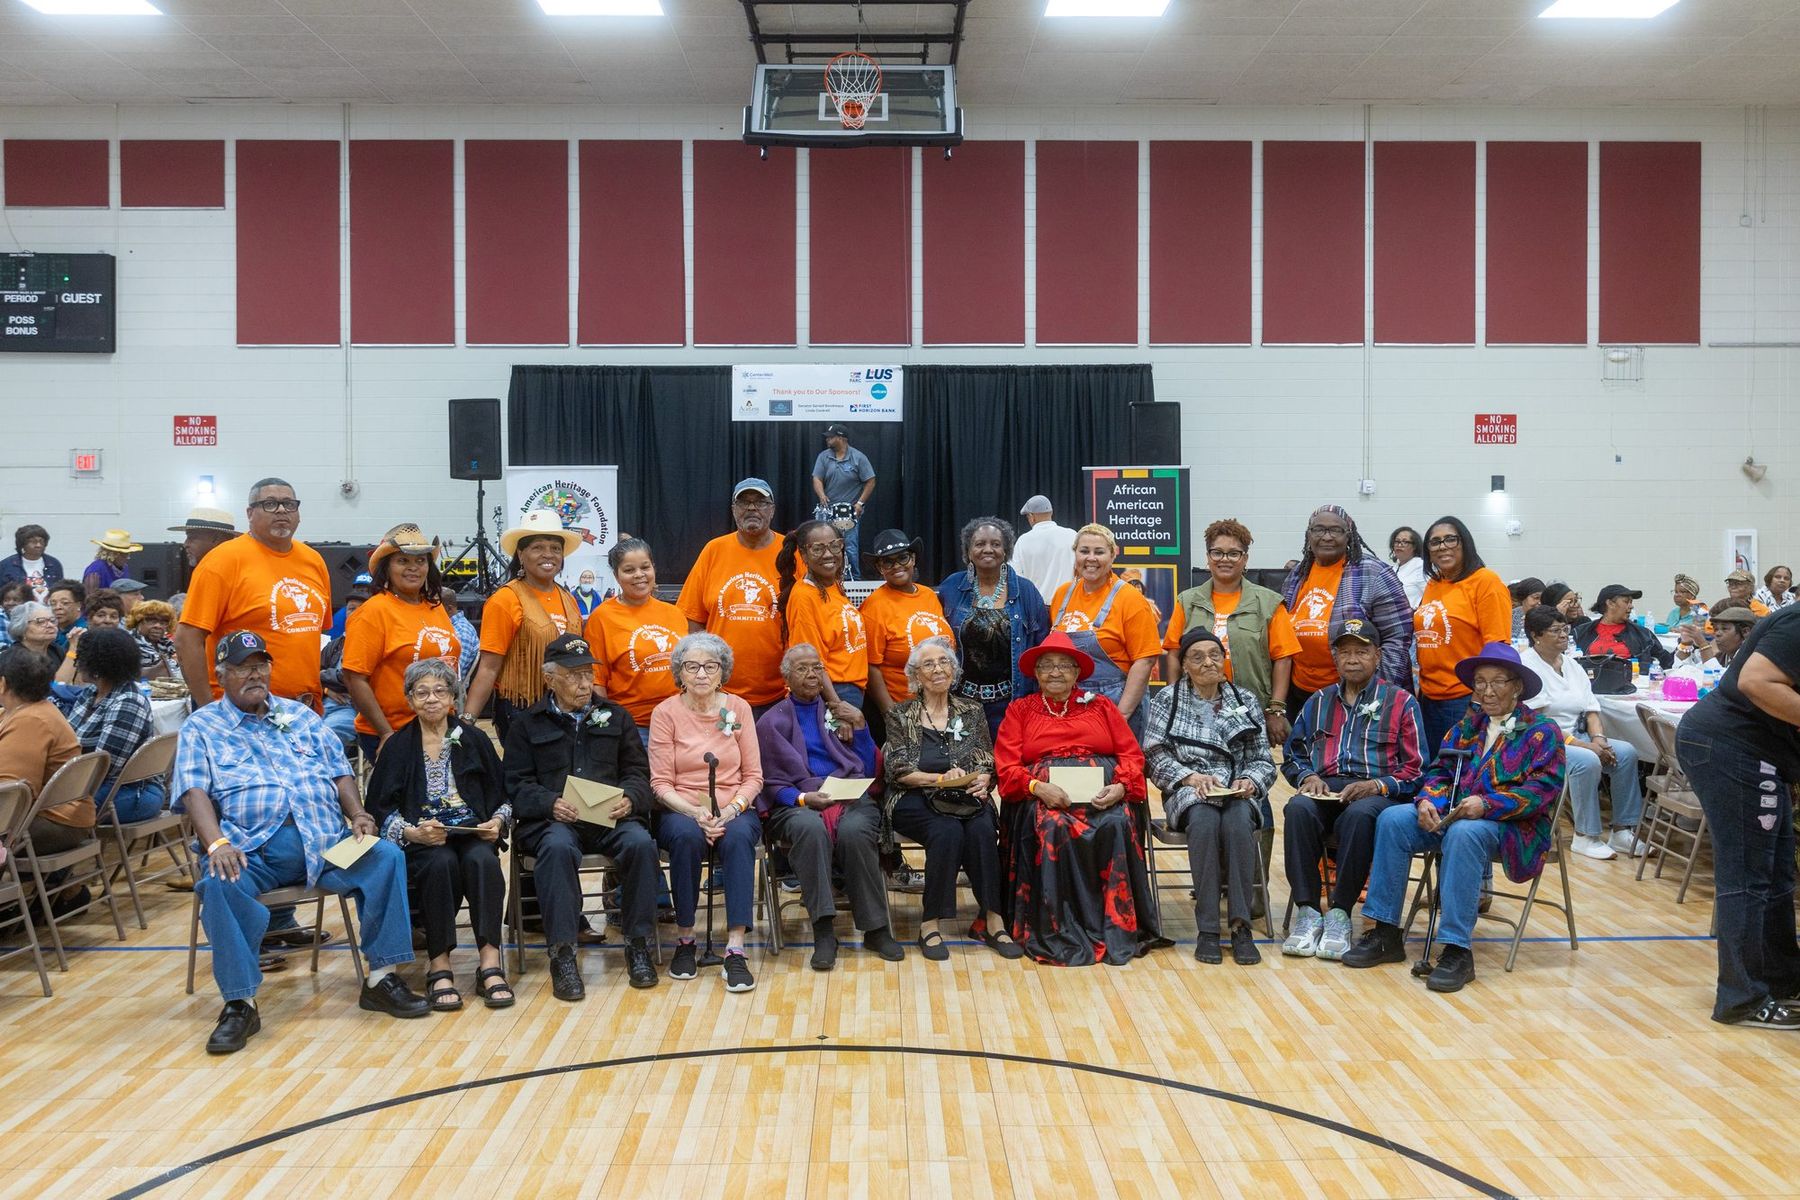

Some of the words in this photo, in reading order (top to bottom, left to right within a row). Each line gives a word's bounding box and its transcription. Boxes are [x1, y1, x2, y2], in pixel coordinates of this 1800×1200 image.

[61, 293, 102, 303] GUEST
[866, 369, 893, 379] LUS
[189, 417, 201, 425] NO
[175, 427, 216, 435] SMOKING
[1476, 425, 1516, 433] SMOKING
[176, 436, 215, 445] ALLOWED
[1477, 434, 1515, 442] ALLOWED
[77, 455, 95, 470] EXIT
[1113, 484, 1156, 495] African
[1106, 500, 1164, 510] American
[520, 484, 553, 513] American
[555, 480, 591, 498] Heritage
[591, 496, 609, 544] Foundation
[1109, 515, 1162, 527] Heritage
[1114, 530, 1170, 540] undation
[720, 573, 744, 594] American
[744, 572, 769, 586] Heritage
